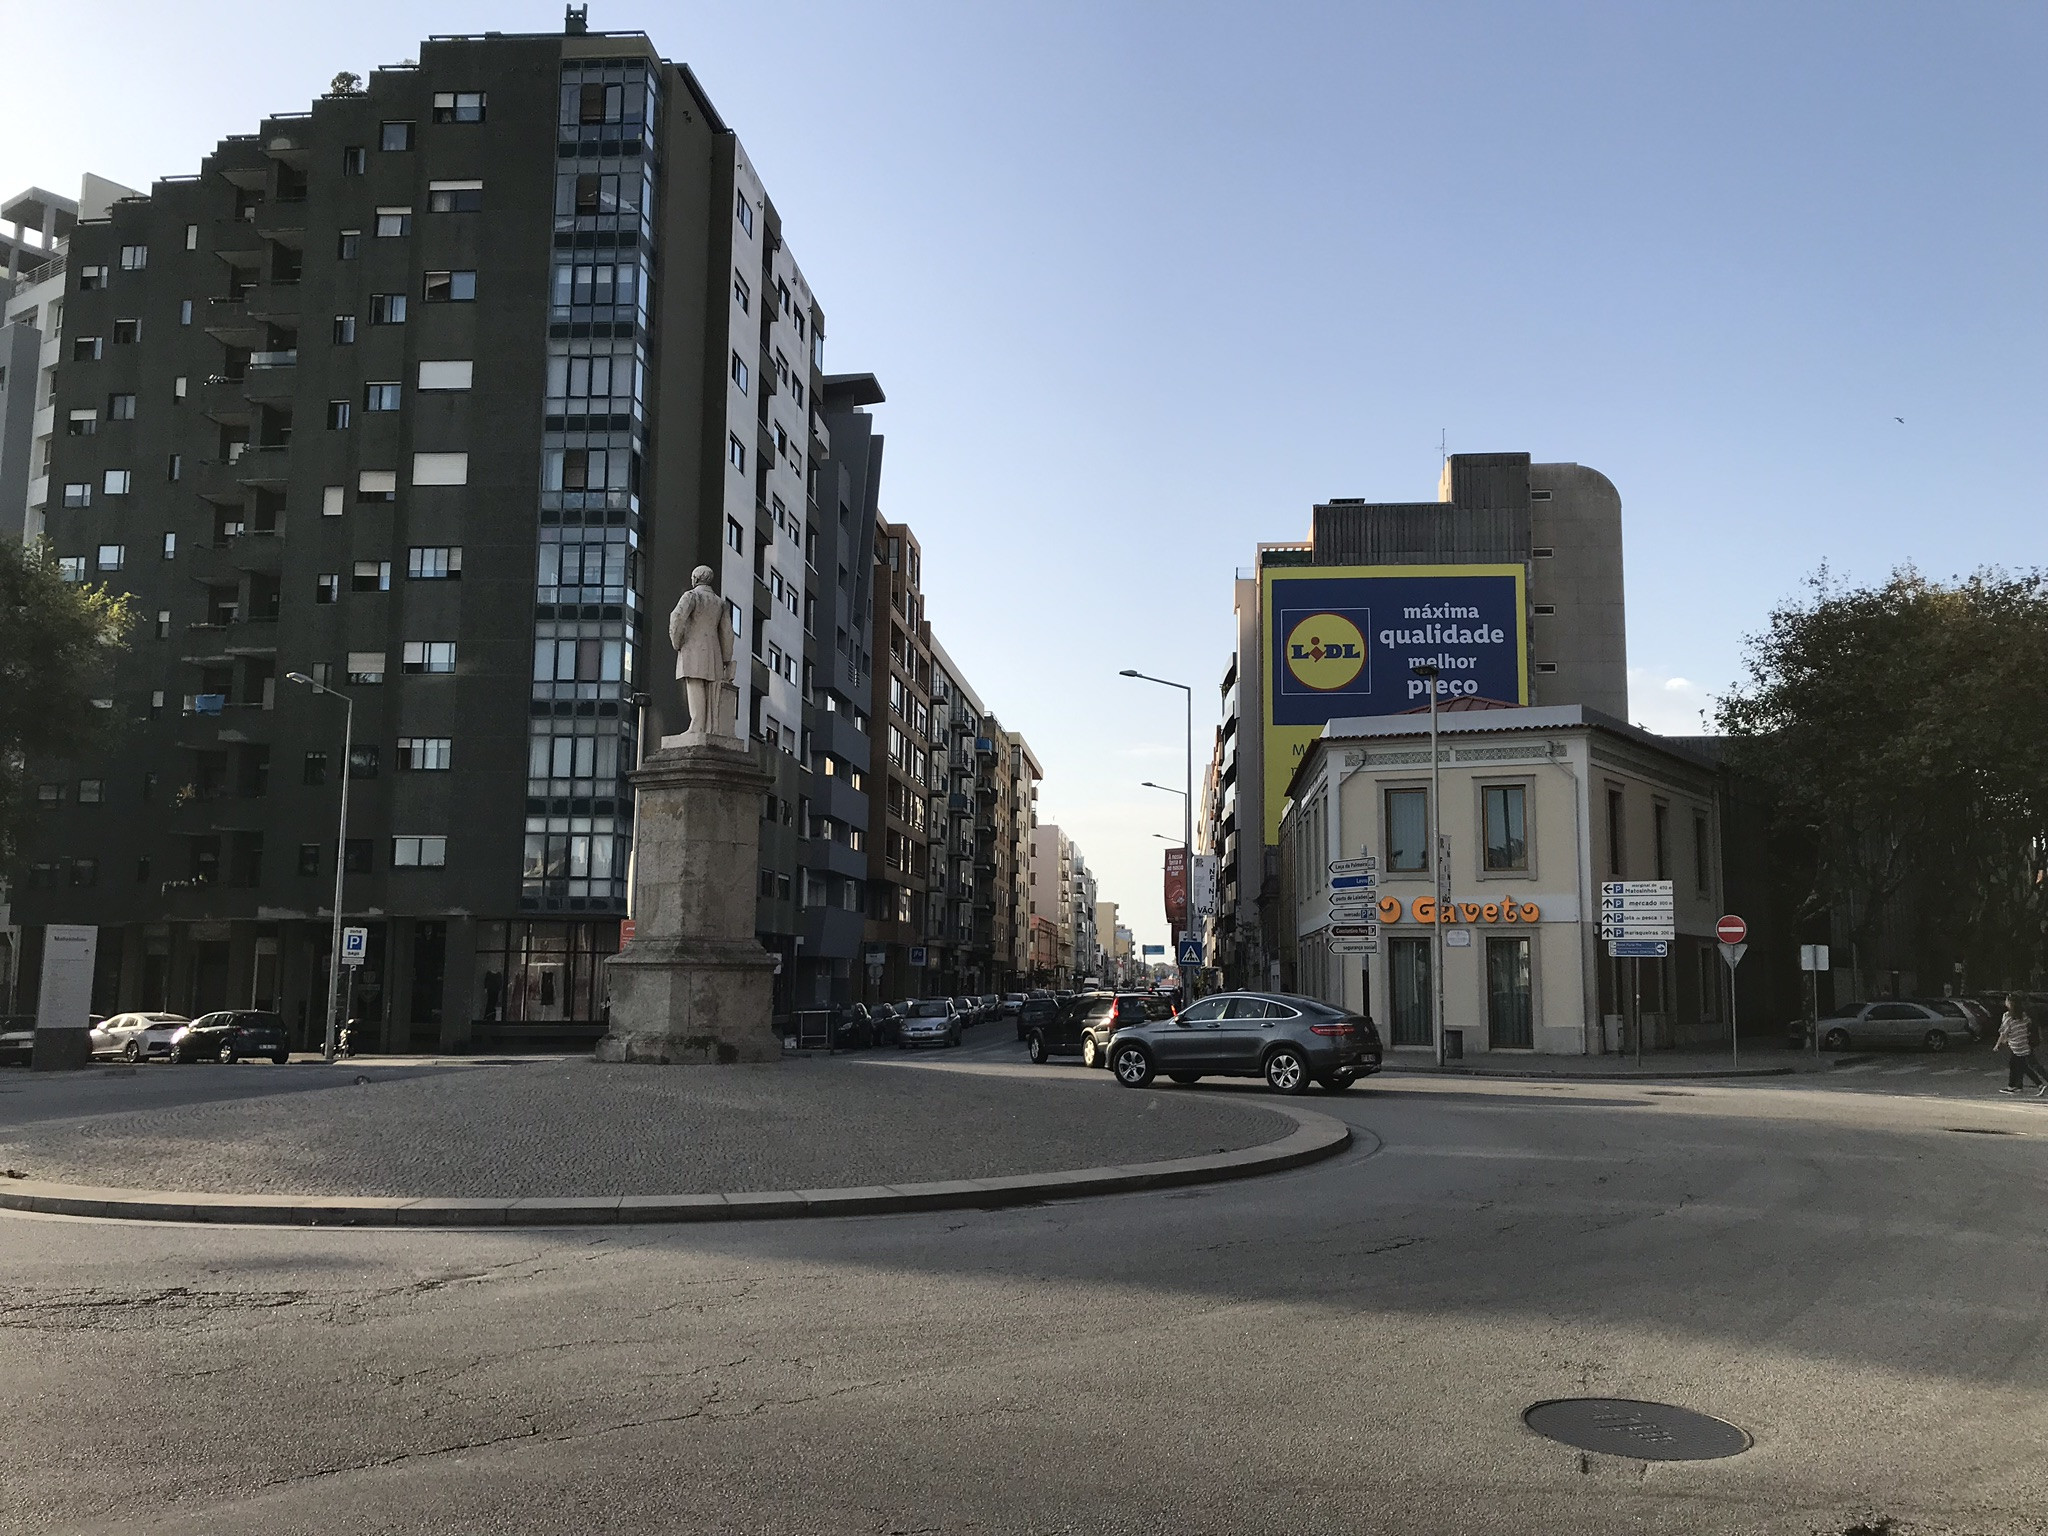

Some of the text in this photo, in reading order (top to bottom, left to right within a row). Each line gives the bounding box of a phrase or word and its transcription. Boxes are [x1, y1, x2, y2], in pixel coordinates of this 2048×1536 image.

[1403, 602, 1480, 619] máxima
[1379, 623, 1504, 649] qualidade
[1407, 654, 1477, 669] melhor
[1407, 678, 1479, 699] preço
[1377, 894, 1540, 924] O Gaveto
